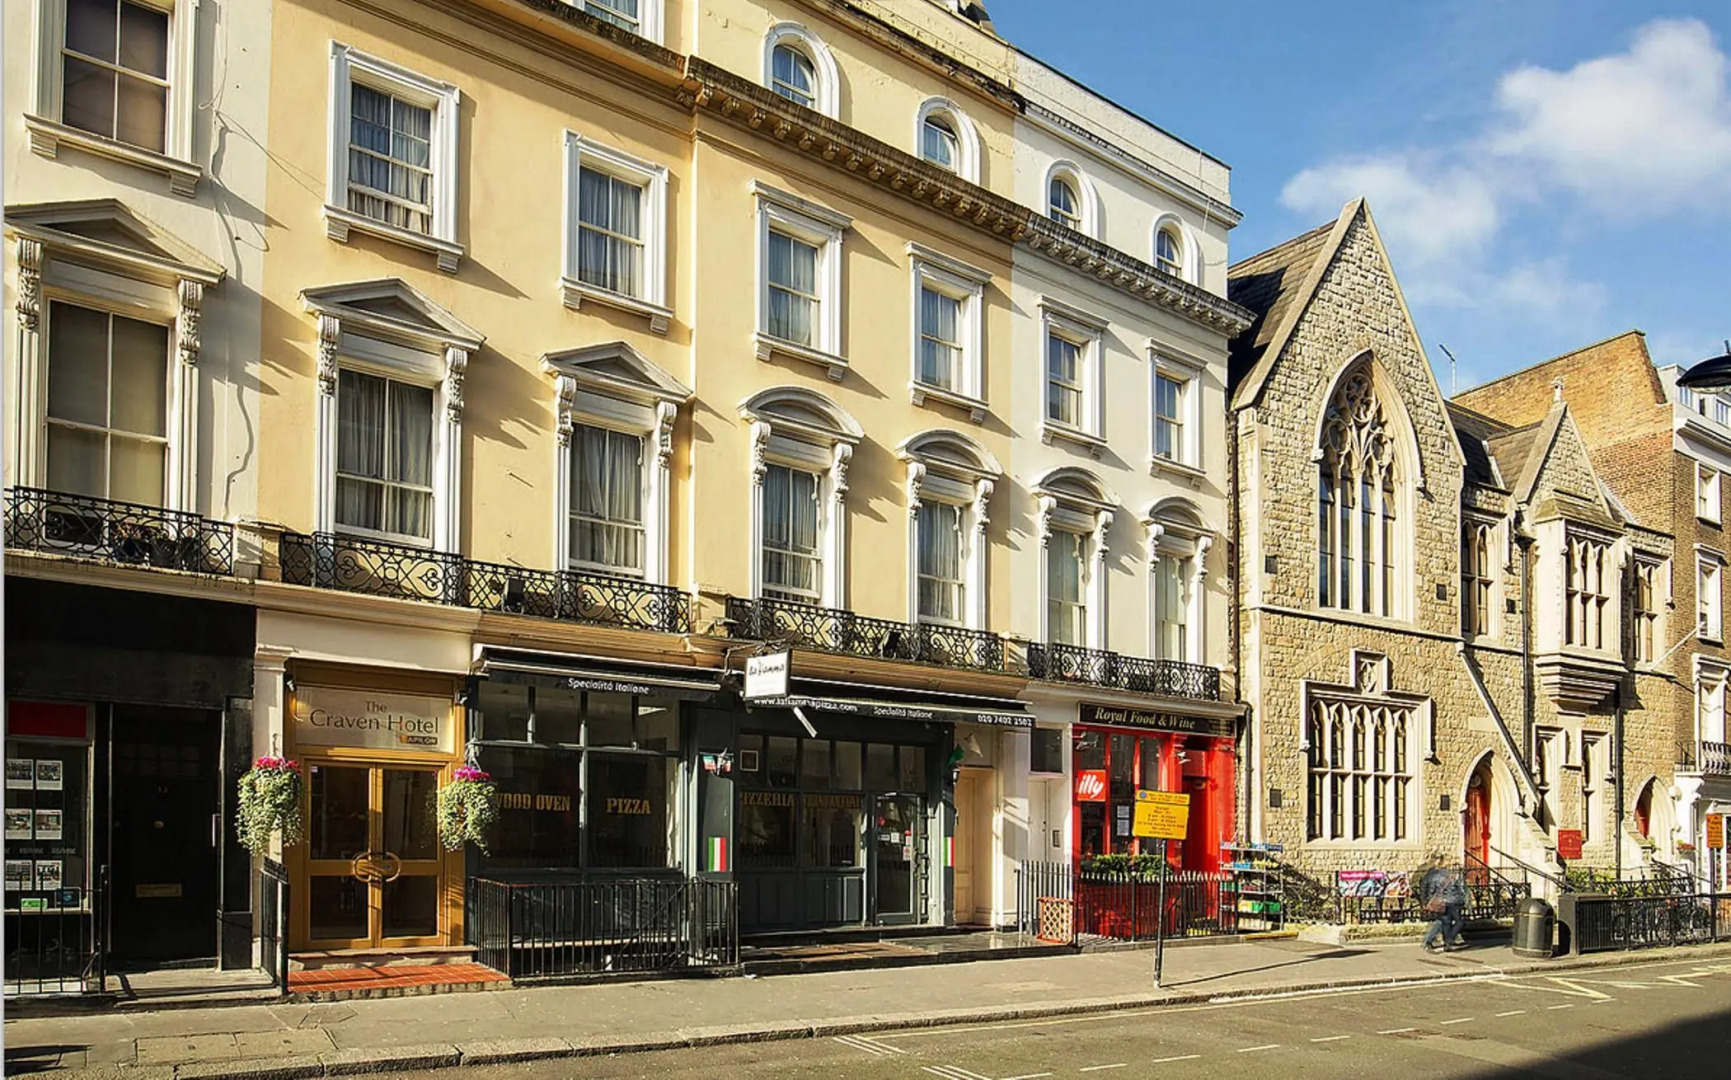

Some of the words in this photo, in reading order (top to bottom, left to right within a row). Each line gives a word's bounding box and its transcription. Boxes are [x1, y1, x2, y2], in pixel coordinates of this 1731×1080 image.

[365, 700, 388, 713] The
[309, 709, 380, 730] Craven
[387, 714, 439, 734] Hotel
[977, 714, 993, 724] 020
[1094, 707, 1128, 724] Royal
[1130, 711, 1156, 725] Food
[1157, 714, 1167, 727] &
[1168, 715, 1196, 729] Wine
[1078, 773, 1104, 799] illy
[535, 794, 571, 811] OVEN
[606, 797, 652, 814] PIZZA
